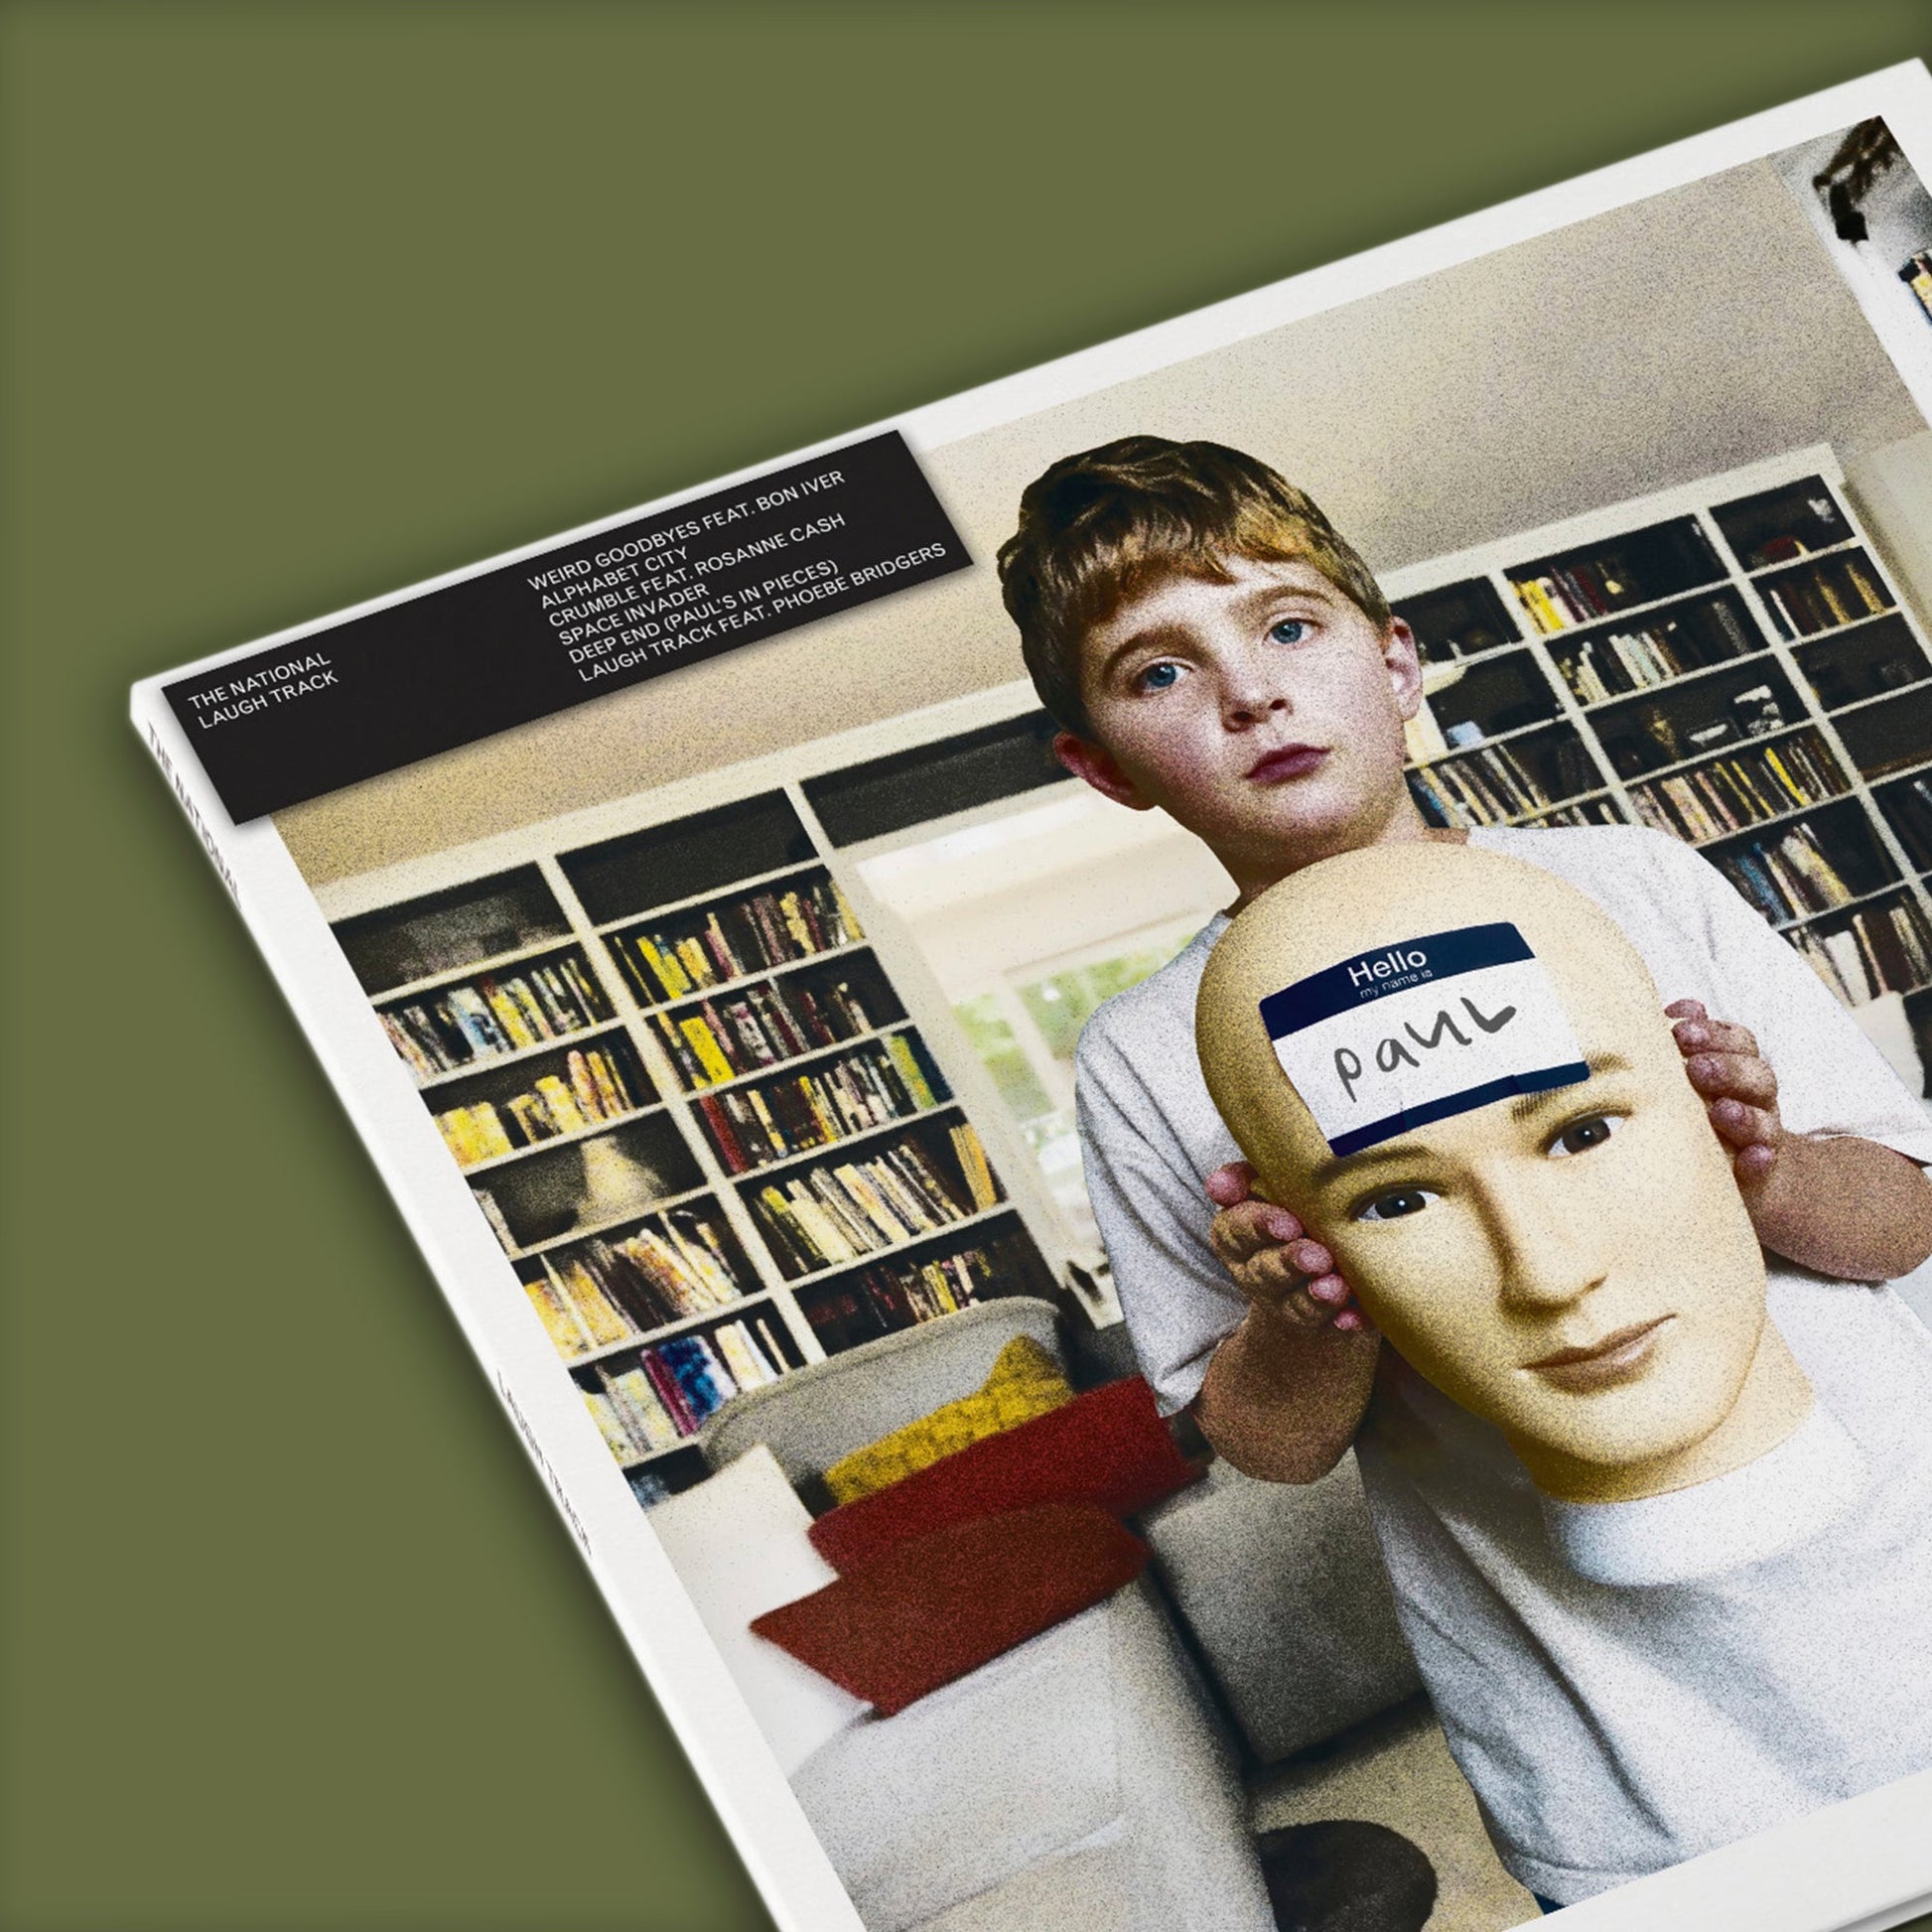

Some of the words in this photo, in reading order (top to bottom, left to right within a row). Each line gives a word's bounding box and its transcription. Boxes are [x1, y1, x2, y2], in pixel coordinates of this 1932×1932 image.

[527, 558, 592, 591] WEIRD
[595, 522, 700, 569] GOODBYES
[702, 503, 756, 530] FEAT.
[756, 486, 799, 511] BON
[801, 471, 846, 495] IVER
[541, 563, 641, 609] ALPHABET
[645, 547, 688, 572] CITY
[549, 587, 639, 626] CRUMBLE
[640, 568, 694, 595] FEAT.
[694, 533, 788, 577] ROSANNE
[790, 513, 846, 541] CASH
[559, 616, 621, 645] SPACE
[623, 583, 710, 622] INVADER
[568, 638, 617, 664] DEEP
[621, 622, 660, 646] END
[739, 586, 760, 605] IN
[763, 559, 839, 597] PIECES)
[578, 648, 647, 682] LAUGH
[649, 624, 717, 656] TRACK
[718, 608, 771, 633] FEAT.
[772, 577, 850, 614] PHOEBE
[852, 542, 946, 588] BRIDGERS
[188, 686, 228, 709] THE
[230, 652, 332, 695] NATIONAL
[199, 695, 268, 729] LAUGH
[268, 670, 339, 703] TRACK
[1348, 949, 1428, 987] Hello
[1360, 984, 1379, 999] my
[1382, 972, 1419, 991] name
[1421, 969, 1433, 979] is
